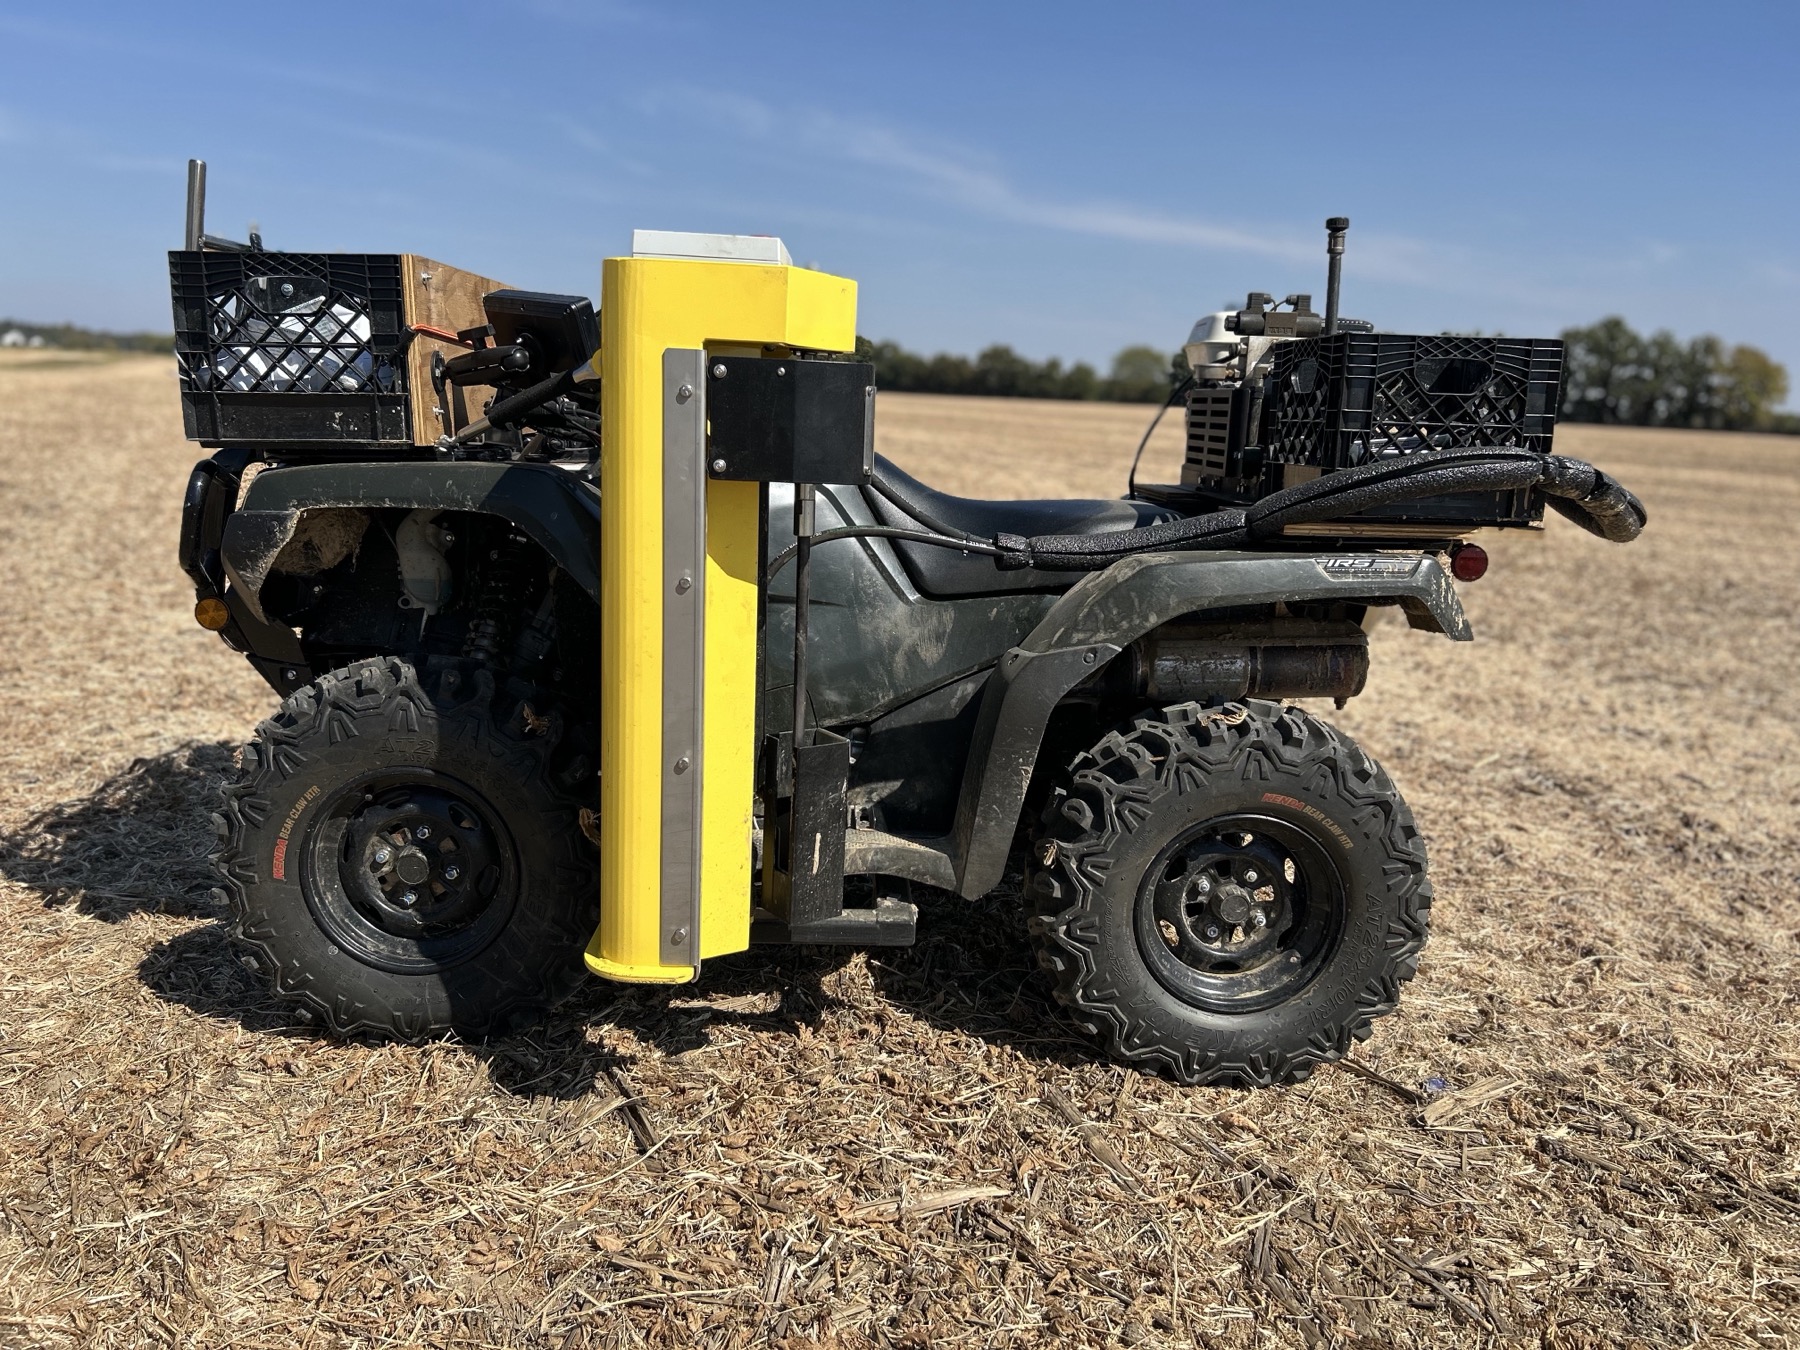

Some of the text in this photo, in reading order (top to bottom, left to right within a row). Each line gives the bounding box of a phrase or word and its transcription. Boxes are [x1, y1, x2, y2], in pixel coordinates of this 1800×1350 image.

[1327, 559, 1372, 567] IRS
[273, 785, 321, 880] KENDA BEAR CLAW HTR
[1261, 793, 1354, 850] KENDA BEAR CLAW HTR
